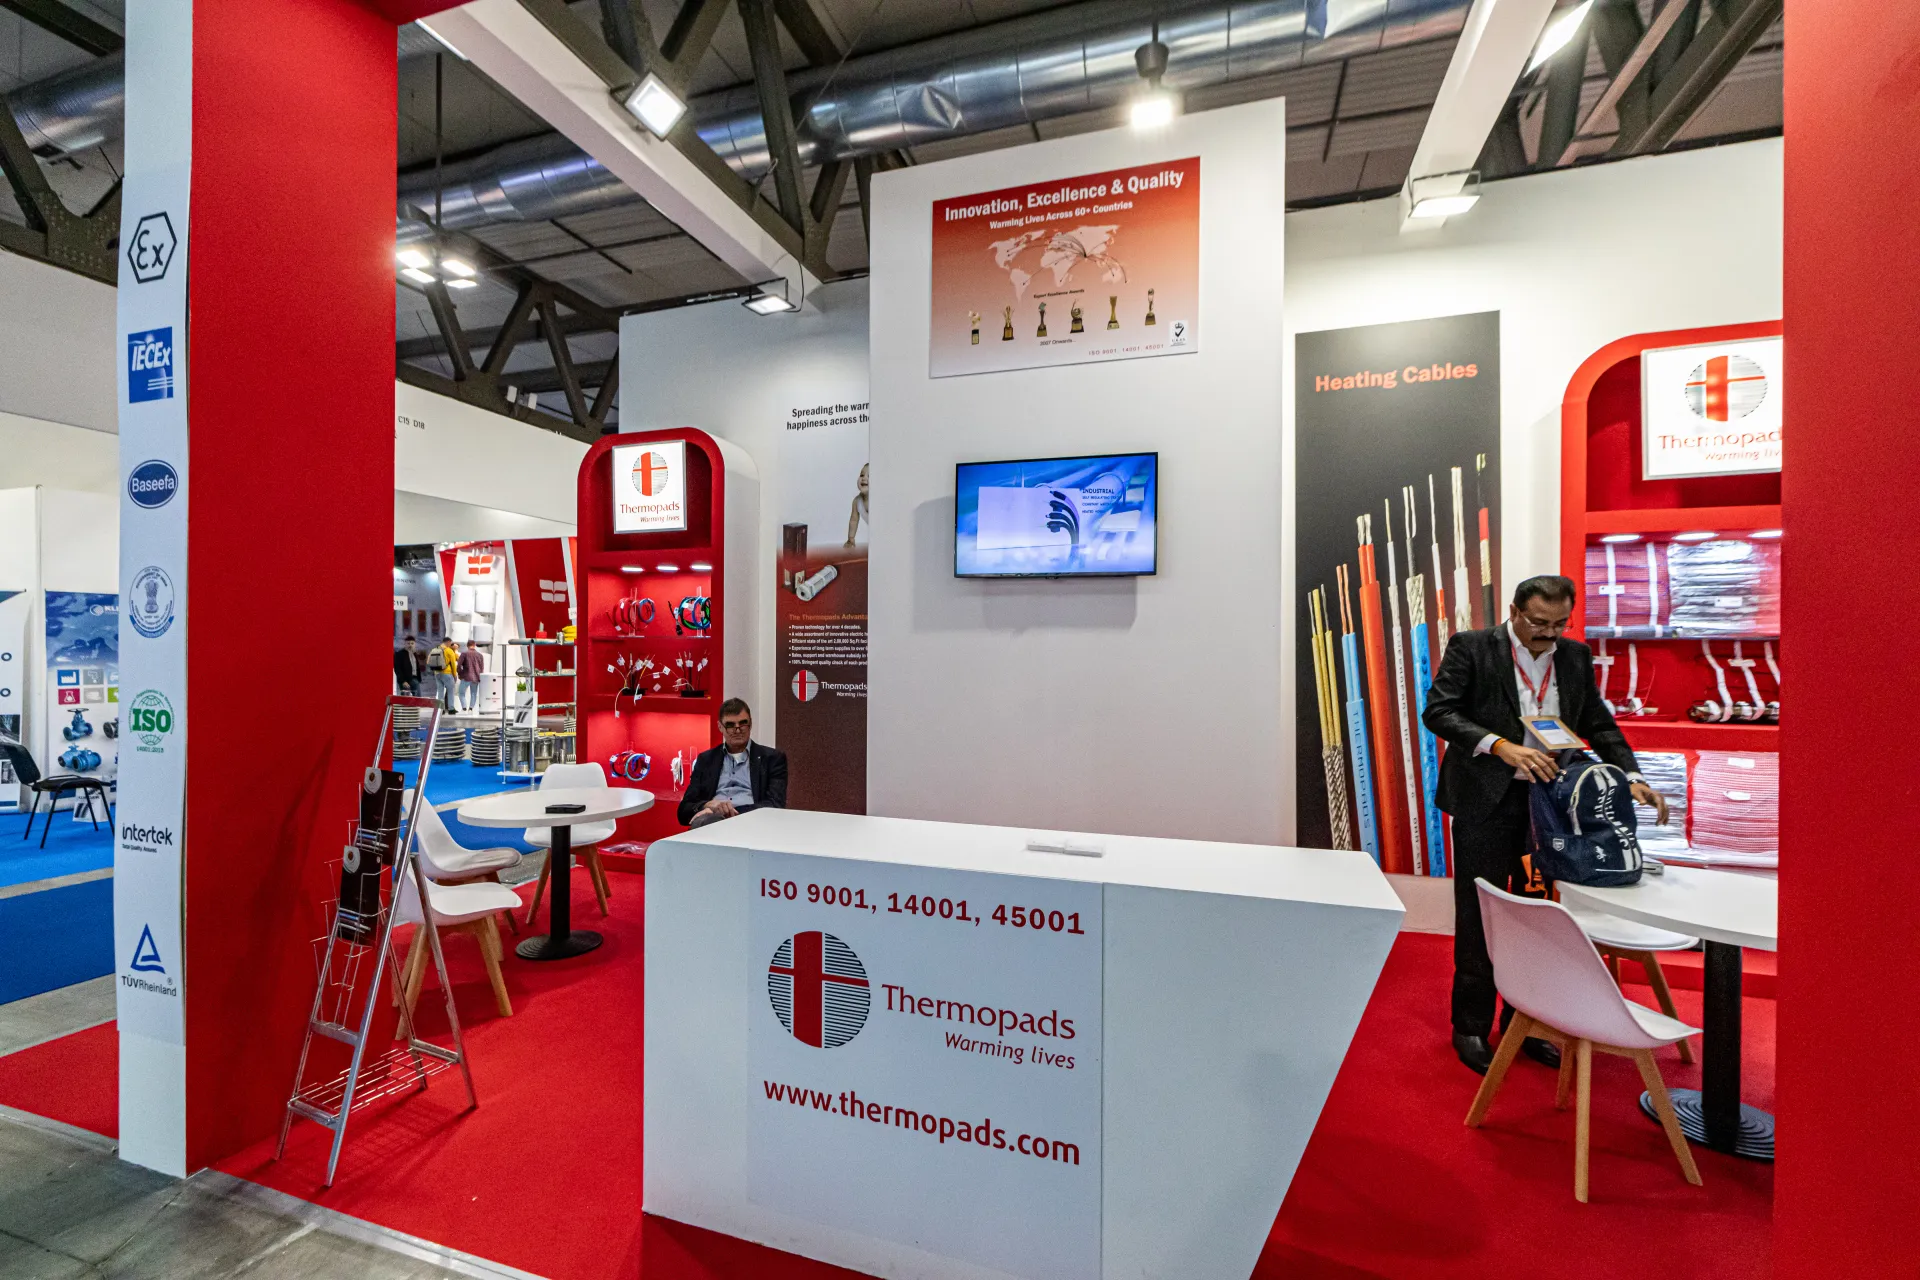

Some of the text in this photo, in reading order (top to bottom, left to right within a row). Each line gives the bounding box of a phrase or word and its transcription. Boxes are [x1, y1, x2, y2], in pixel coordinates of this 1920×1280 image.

[945, 170, 1184, 221] Innovation, Excellence & Quality
[989, 200, 1133, 230] Warming Lives Across 60+ Countries
[132, 341, 171, 372] IECEx
[1316, 362, 1478, 392] Heating Cables
[786, 420, 828, 431] happiness
[830, 416, 857, 425] across
[792, 406, 834, 418] Spreading
[835, 404, 848, 412] the
[132, 474, 174, 493] Baseefa
[620, 501, 680, 514] Thermopads
[132, 708, 171, 732] ISO
[1353, 711, 1370, 830] THERMOPADS
[122, 822, 172, 846] intertek
[761, 878, 1085, 934] ISO 9001, 14001, 45001
[882, 984, 1076, 1039] Thermopads
[946, 1031, 1075, 1069] Warming lives
[764, 1080, 1080, 1166] www.thermopads.com
